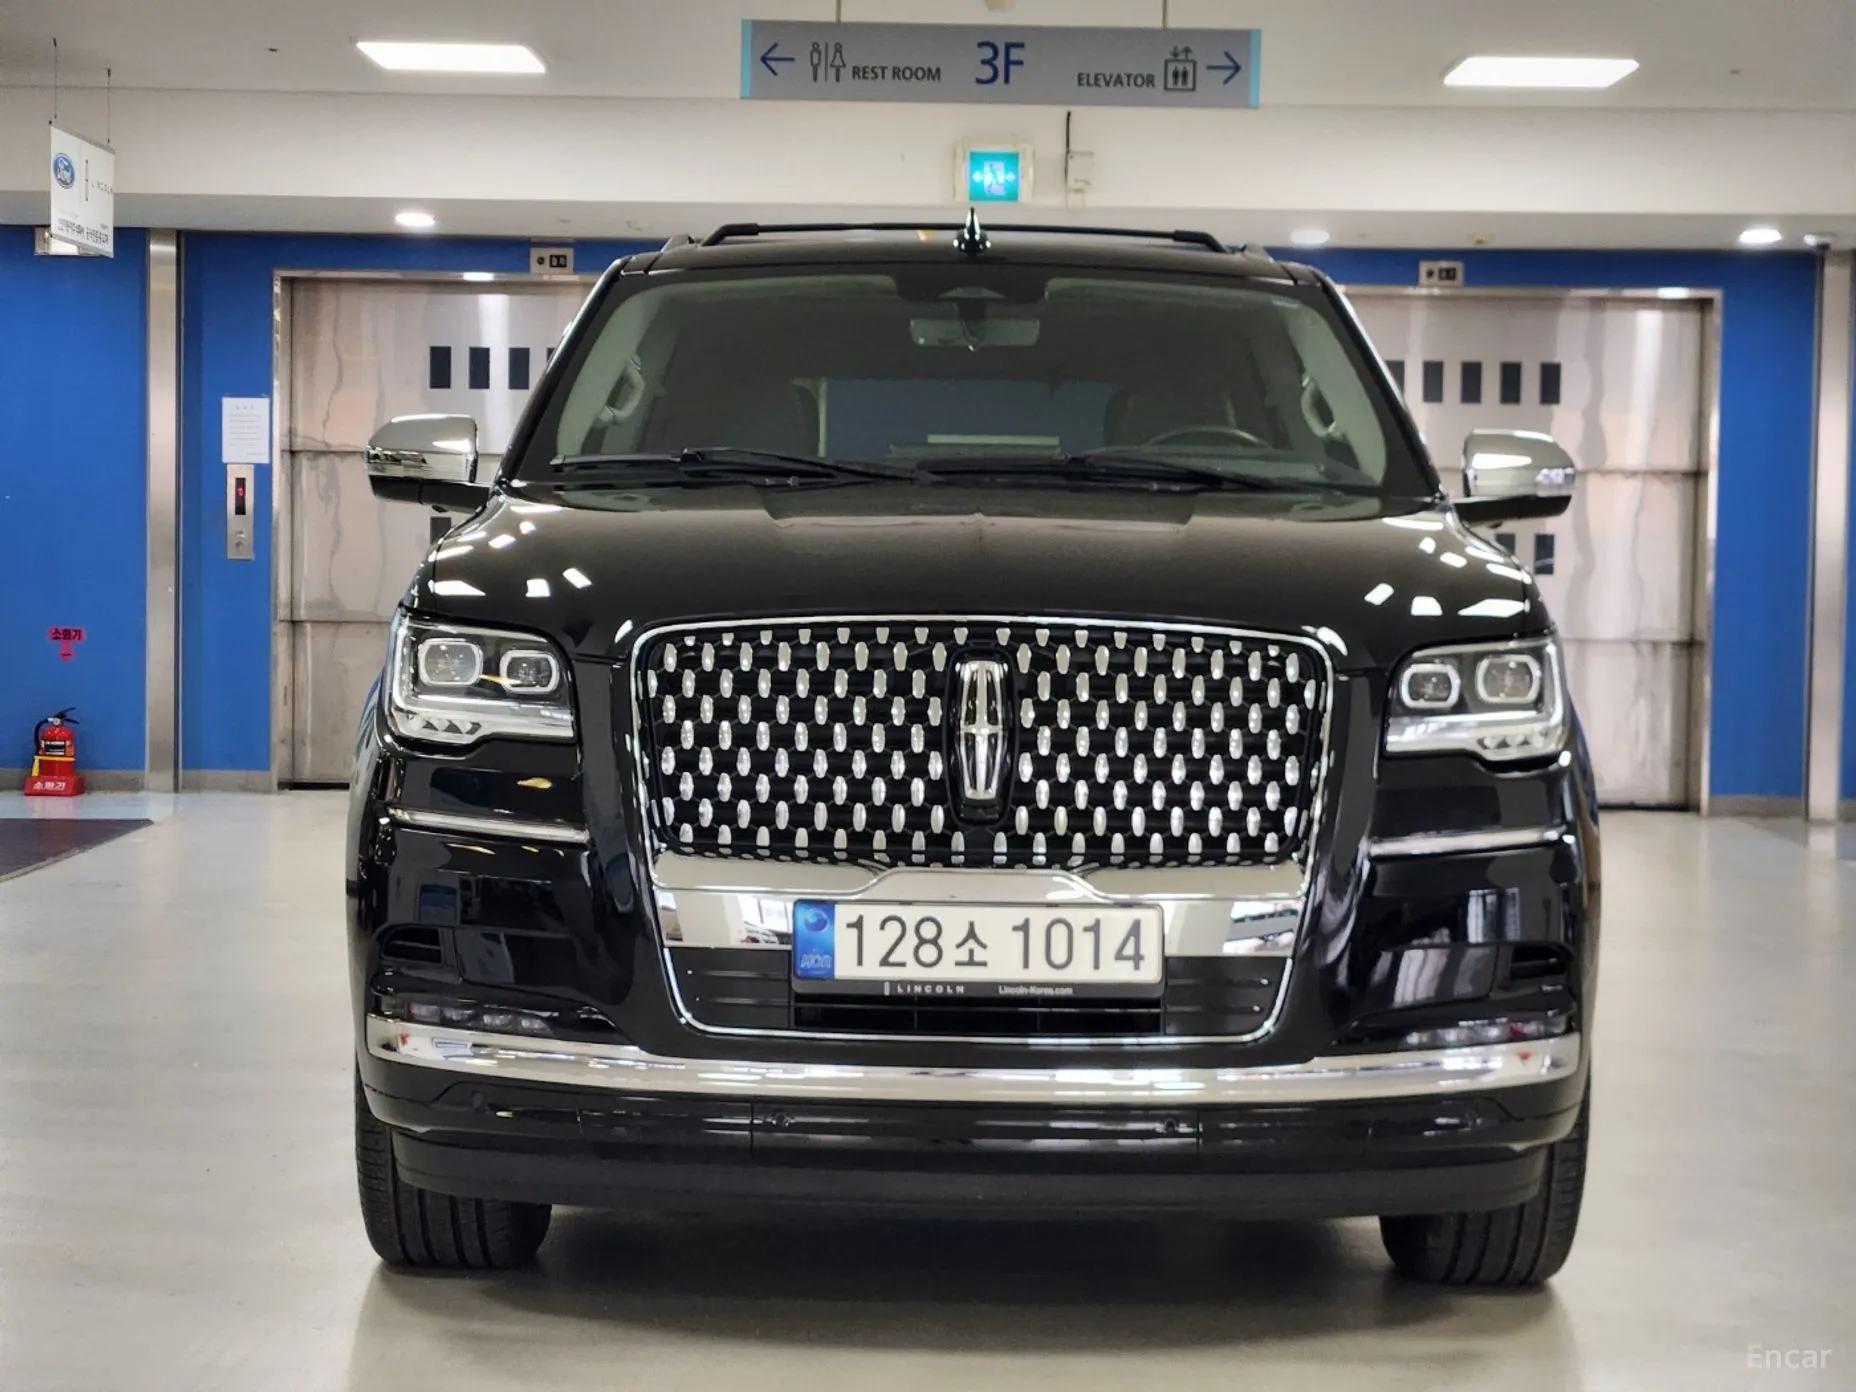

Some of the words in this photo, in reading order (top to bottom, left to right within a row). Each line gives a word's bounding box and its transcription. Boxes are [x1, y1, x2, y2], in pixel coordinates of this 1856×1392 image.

[975, 40, 1025, 85] 3F
[852, 66, 888, 80] REST
[892, 66, 941, 81] ROOM
[1077, 72, 1156, 88] ELEVATOR
[52, 628, 82, 641] 소화기
[846, 914, 988, 968] 128소
[1012, 917, 1145, 971] 1014
[897, 984, 965, 994] LINCOLN
